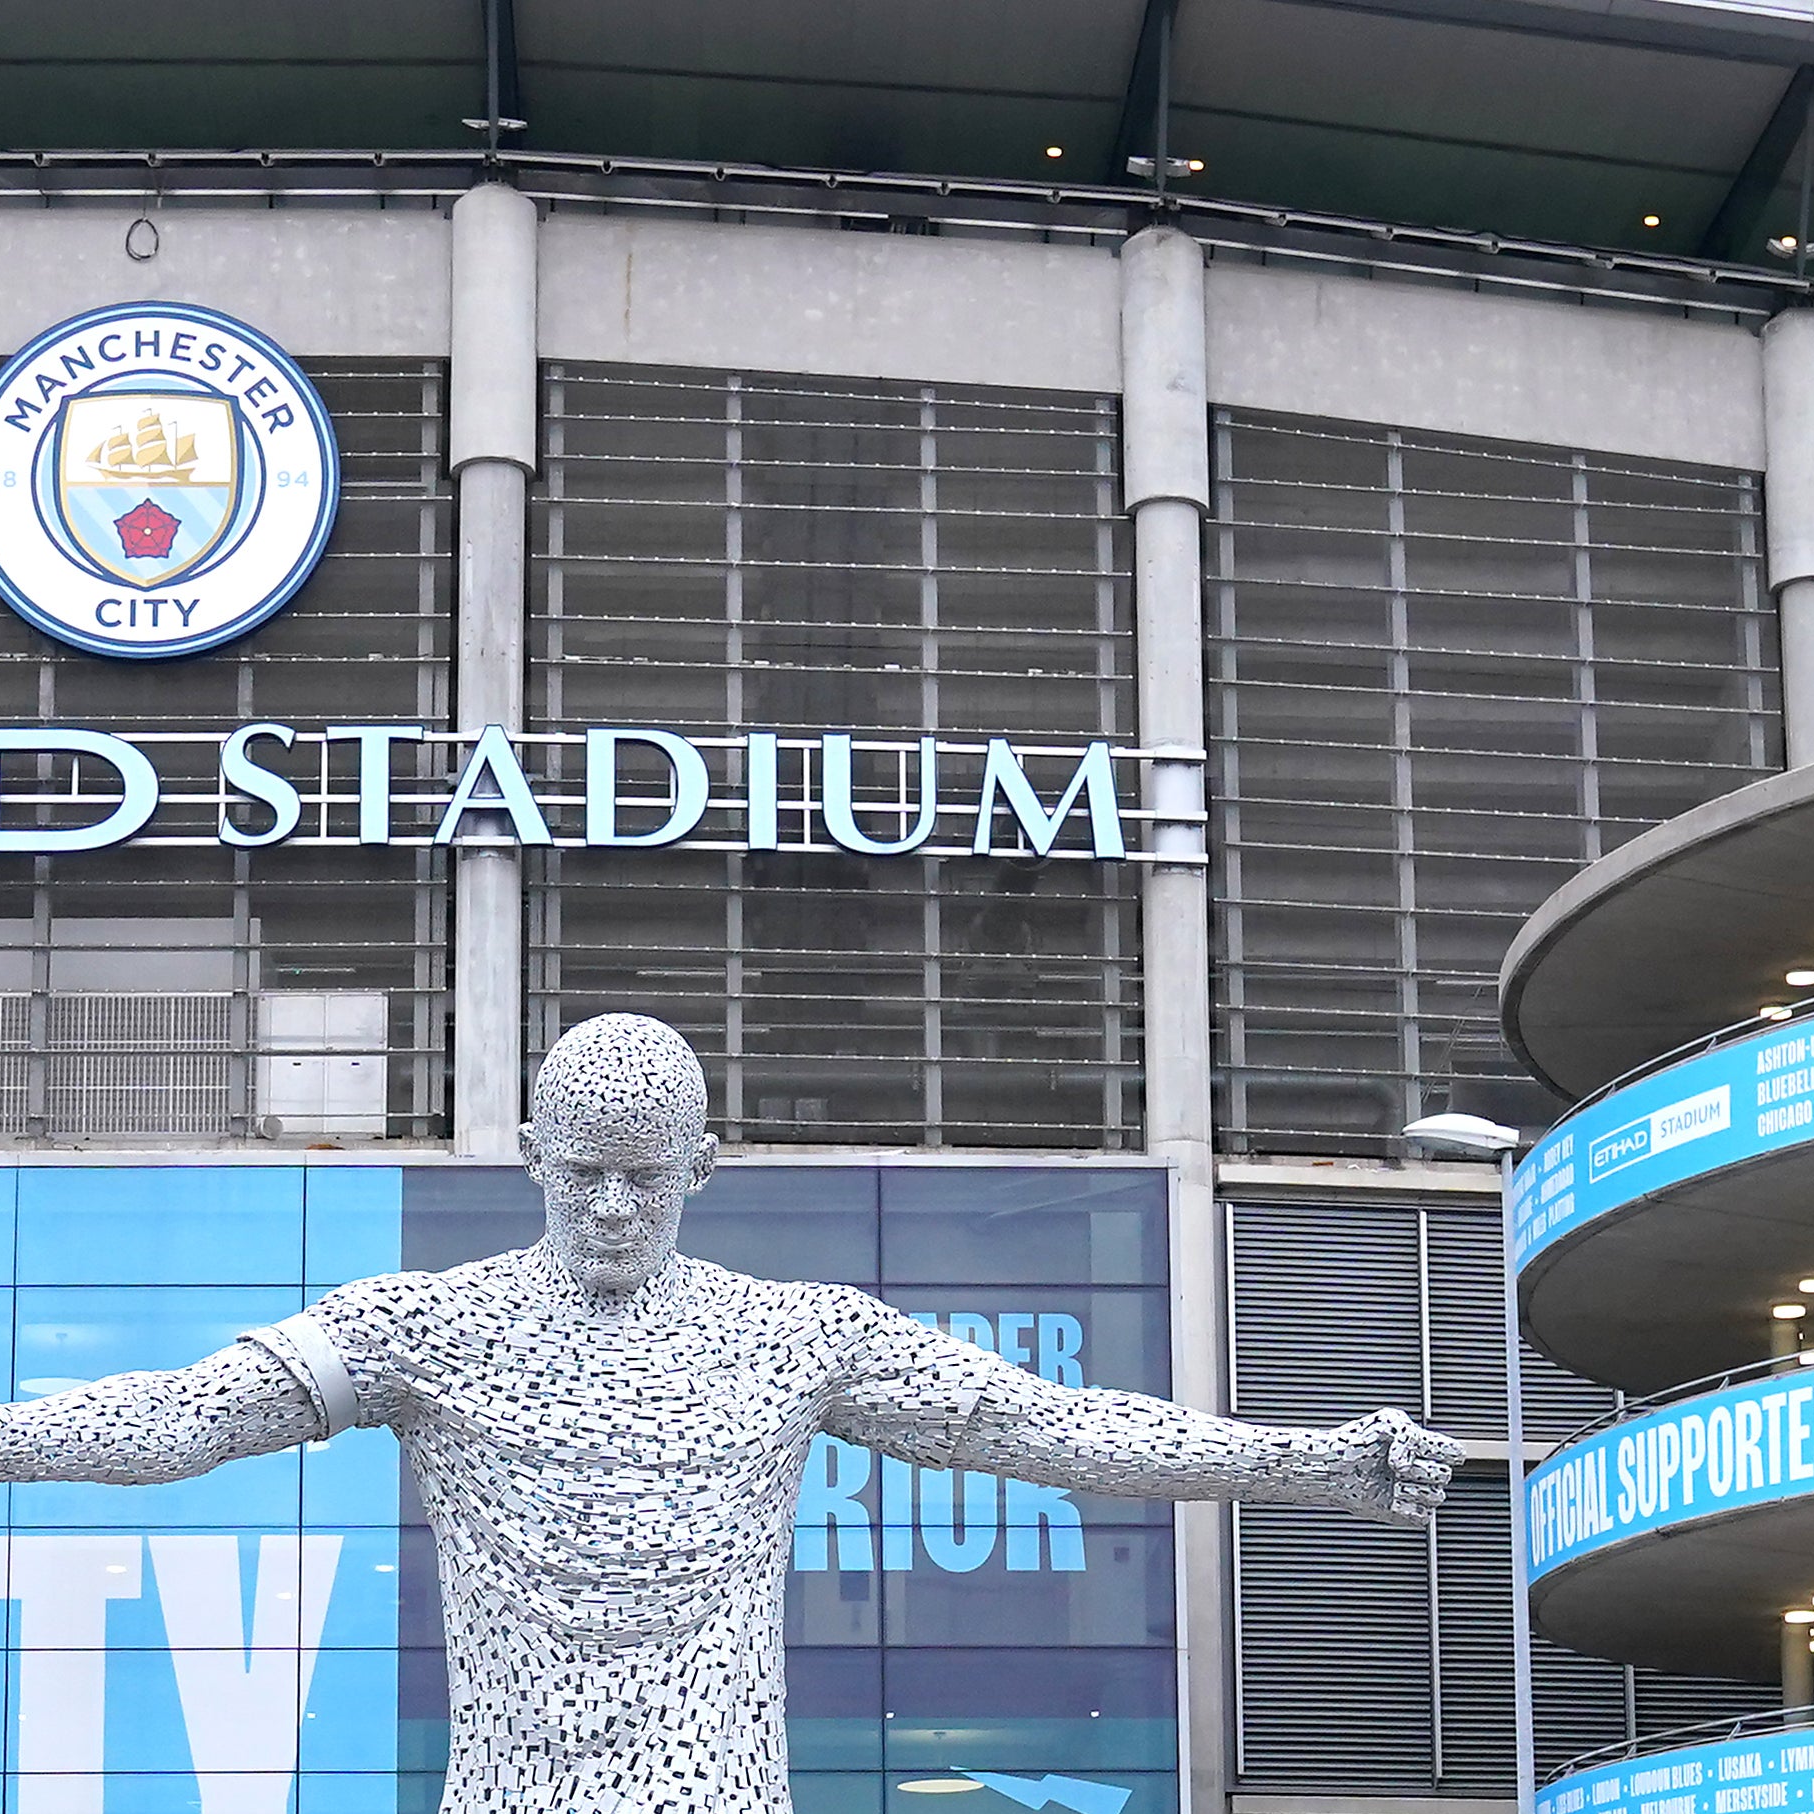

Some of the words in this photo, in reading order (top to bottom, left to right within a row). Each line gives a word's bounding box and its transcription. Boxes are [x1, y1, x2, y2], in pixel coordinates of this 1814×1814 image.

[4, 330, 295, 434] MANCHESTER
[277, 471, 308, 487] 94
[96, 599, 199, 627] CITY
[220, 722, 1127, 860] STADIUM
[1594, 1130, 1648, 1167] ETIHAD
[1660, 1101, 1721, 1138] STADIUM
[1529, 1451, 1615, 1567] OFFICIAL
